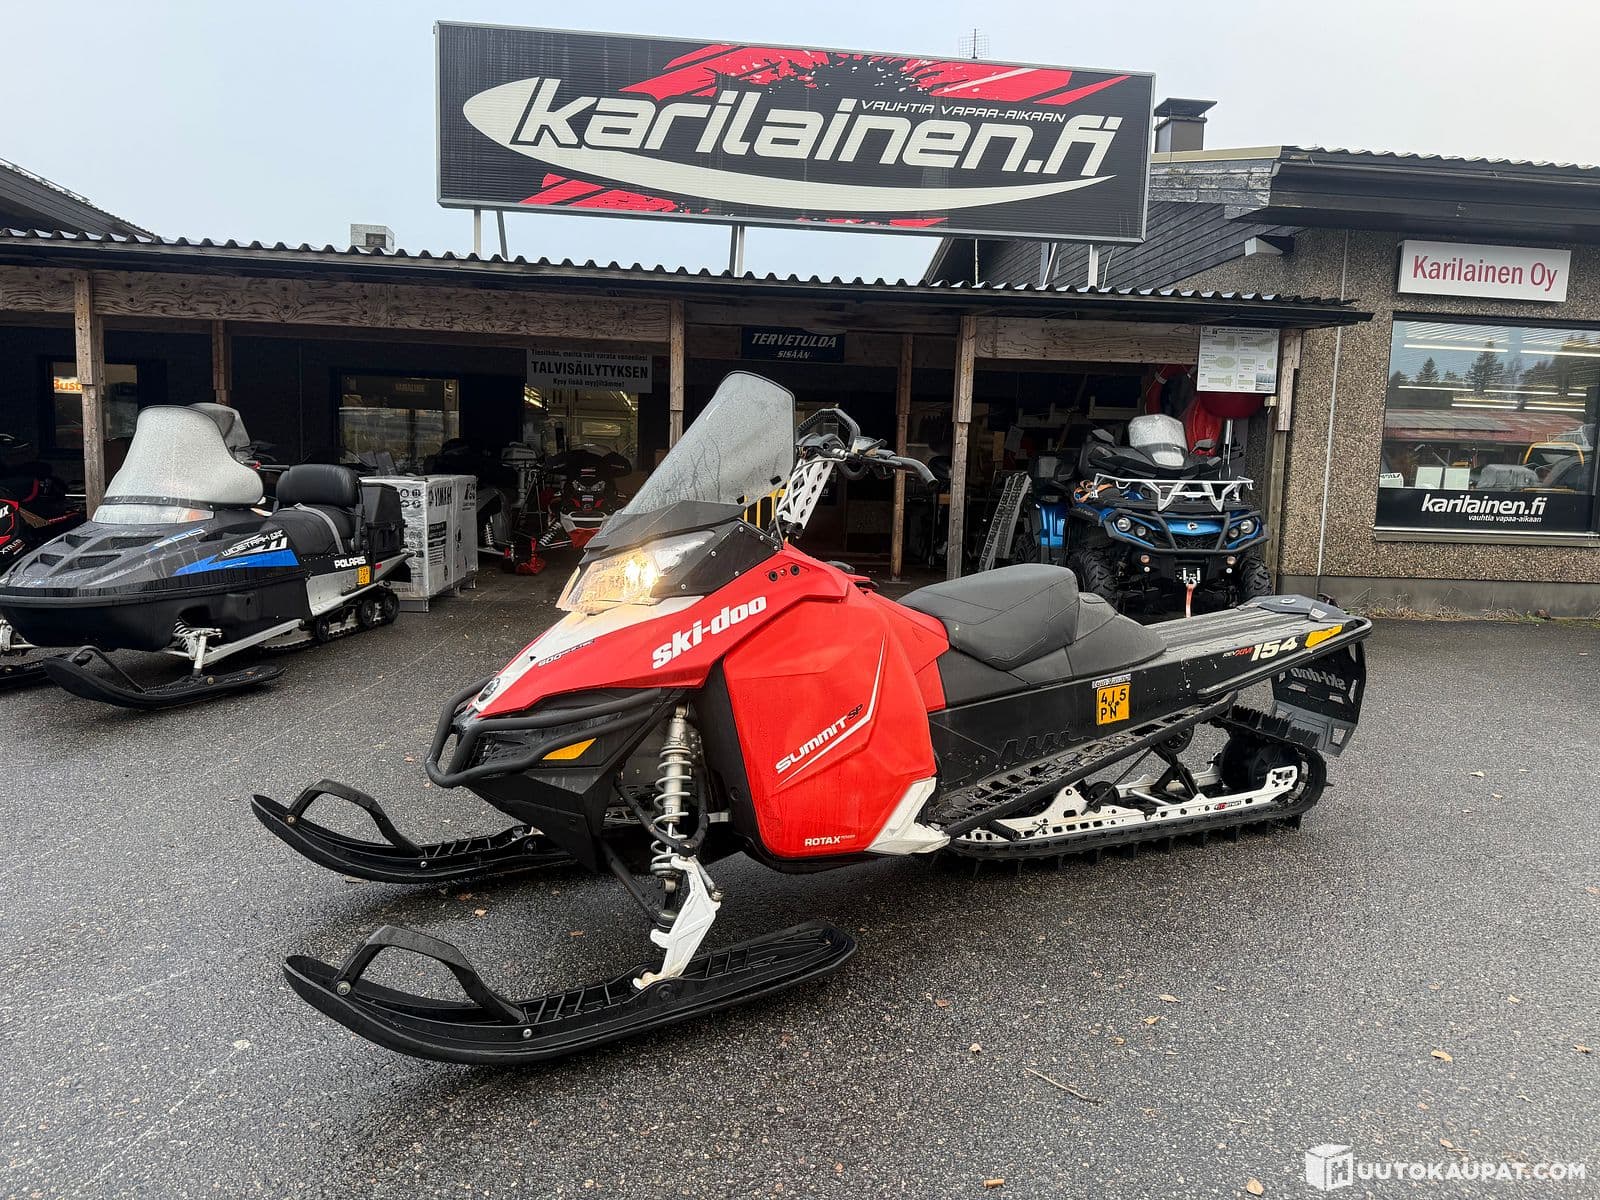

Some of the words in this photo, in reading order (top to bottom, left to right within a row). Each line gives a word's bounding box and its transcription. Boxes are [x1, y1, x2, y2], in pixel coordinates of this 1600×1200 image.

[861, 99, 935, 114] VAUHTIA
[940, 105, 1067, 123] VAPAA-AIKAAN
[516, 77, 1123, 177] karilainen.fi
[1412, 255, 1524, 286] Karilainen
[1529, 262, 1559, 292] Oy
[751, 332, 838, 348] TERVETULOA
[531, 360, 648, 379] TALVISÄILYTYKSEN
[1421, 493, 1548, 515] karilainen.fi
[1468, 514, 1495, 522] vauhtia
[1495, 515, 1542, 524] vapaa-aikaan
[333, 555, 367, 569] POLARIS
[651, 594, 768, 670] ski-doo
[1251, 636, 1298, 662] 154
[1101, 688, 1127, 704] 415
[1101, 705, 1117, 721] PN
[775, 714, 849, 775] SUMMIT
[846, 703, 864, 721] SP
[804, 836, 841, 847] ROTAX
